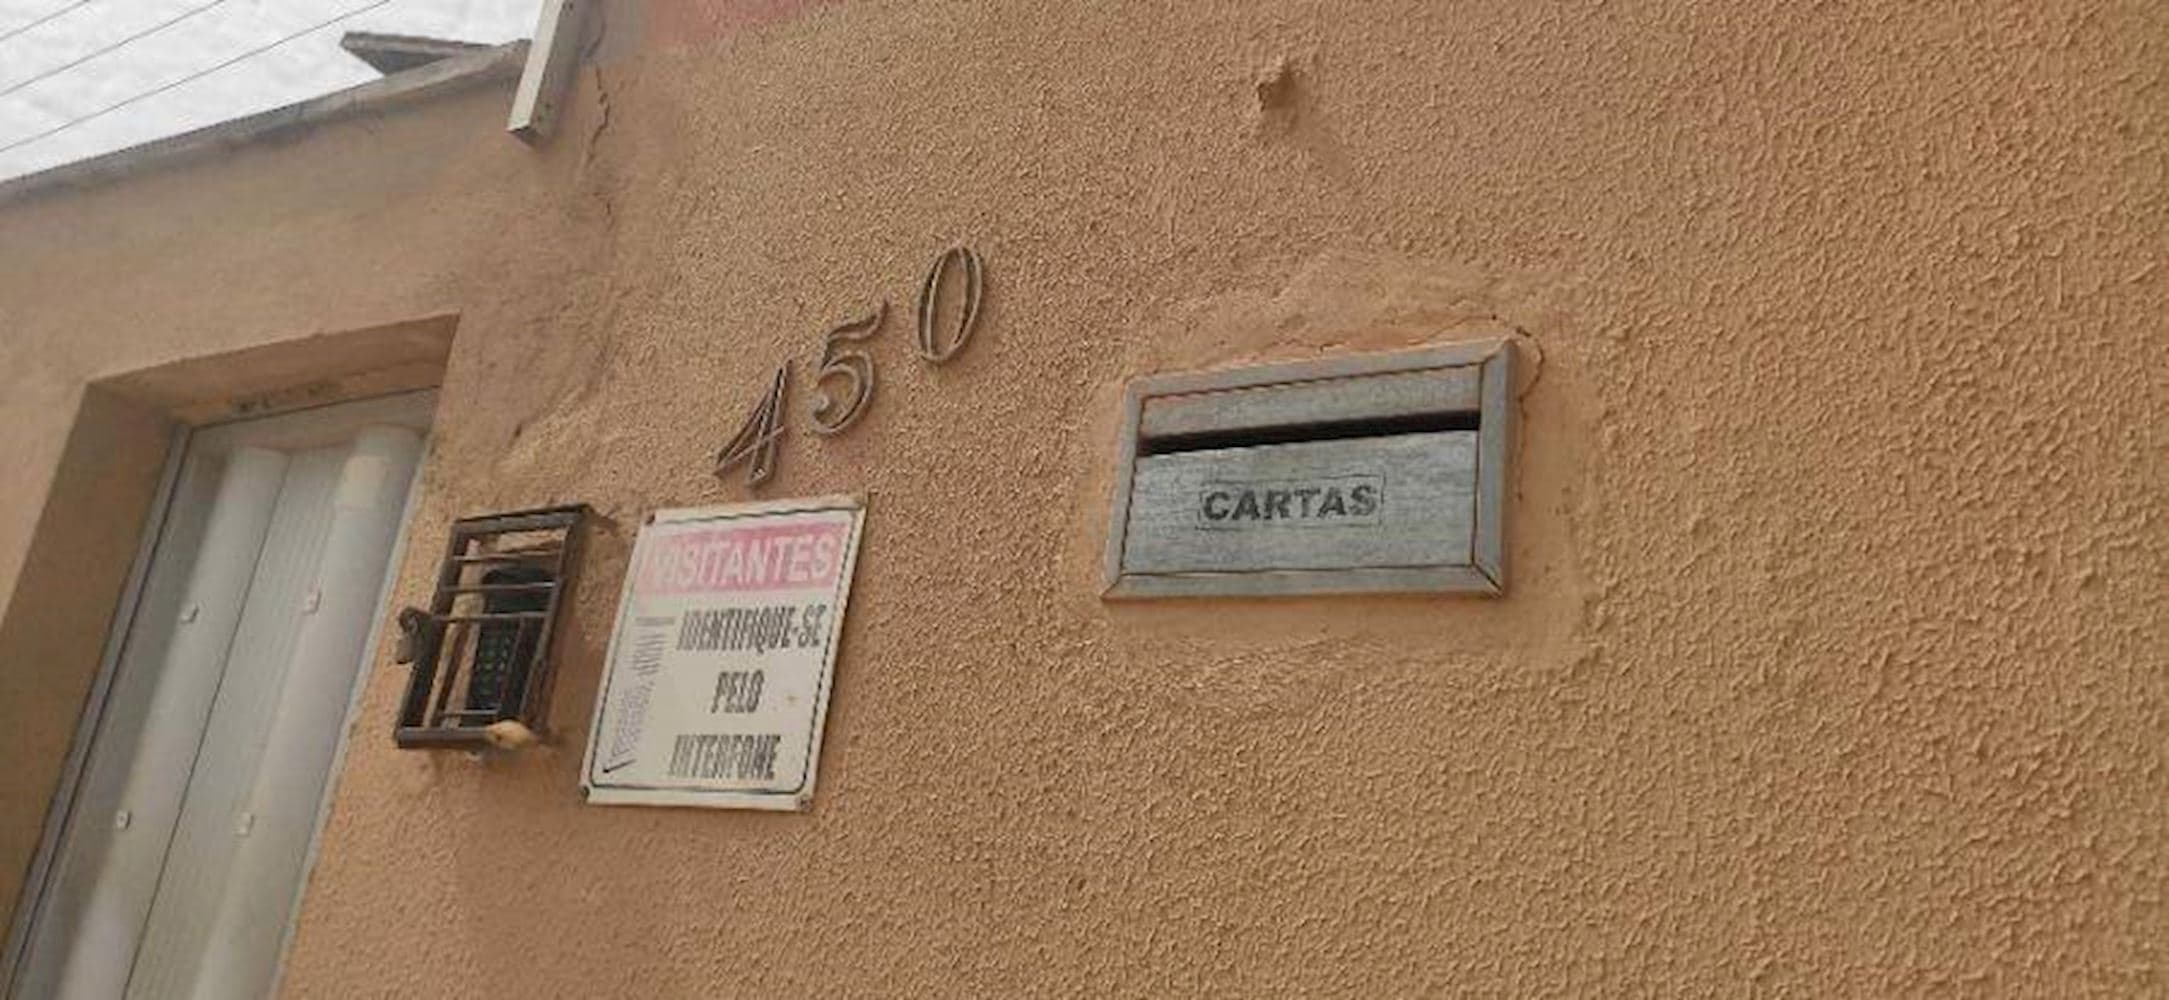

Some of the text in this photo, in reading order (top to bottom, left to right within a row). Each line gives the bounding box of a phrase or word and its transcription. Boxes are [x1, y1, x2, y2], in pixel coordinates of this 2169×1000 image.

[715, 247, 982, 486] 450
[1203, 484, 1377, 521] CARTAS
[653, 533, 836, 586] VISITANTES
[676, 603, 827, 654] IDENTIFIQUE-SE
[711, 669, 765, 714] PELO
[667, 734, 781, 781] INTERFONE
